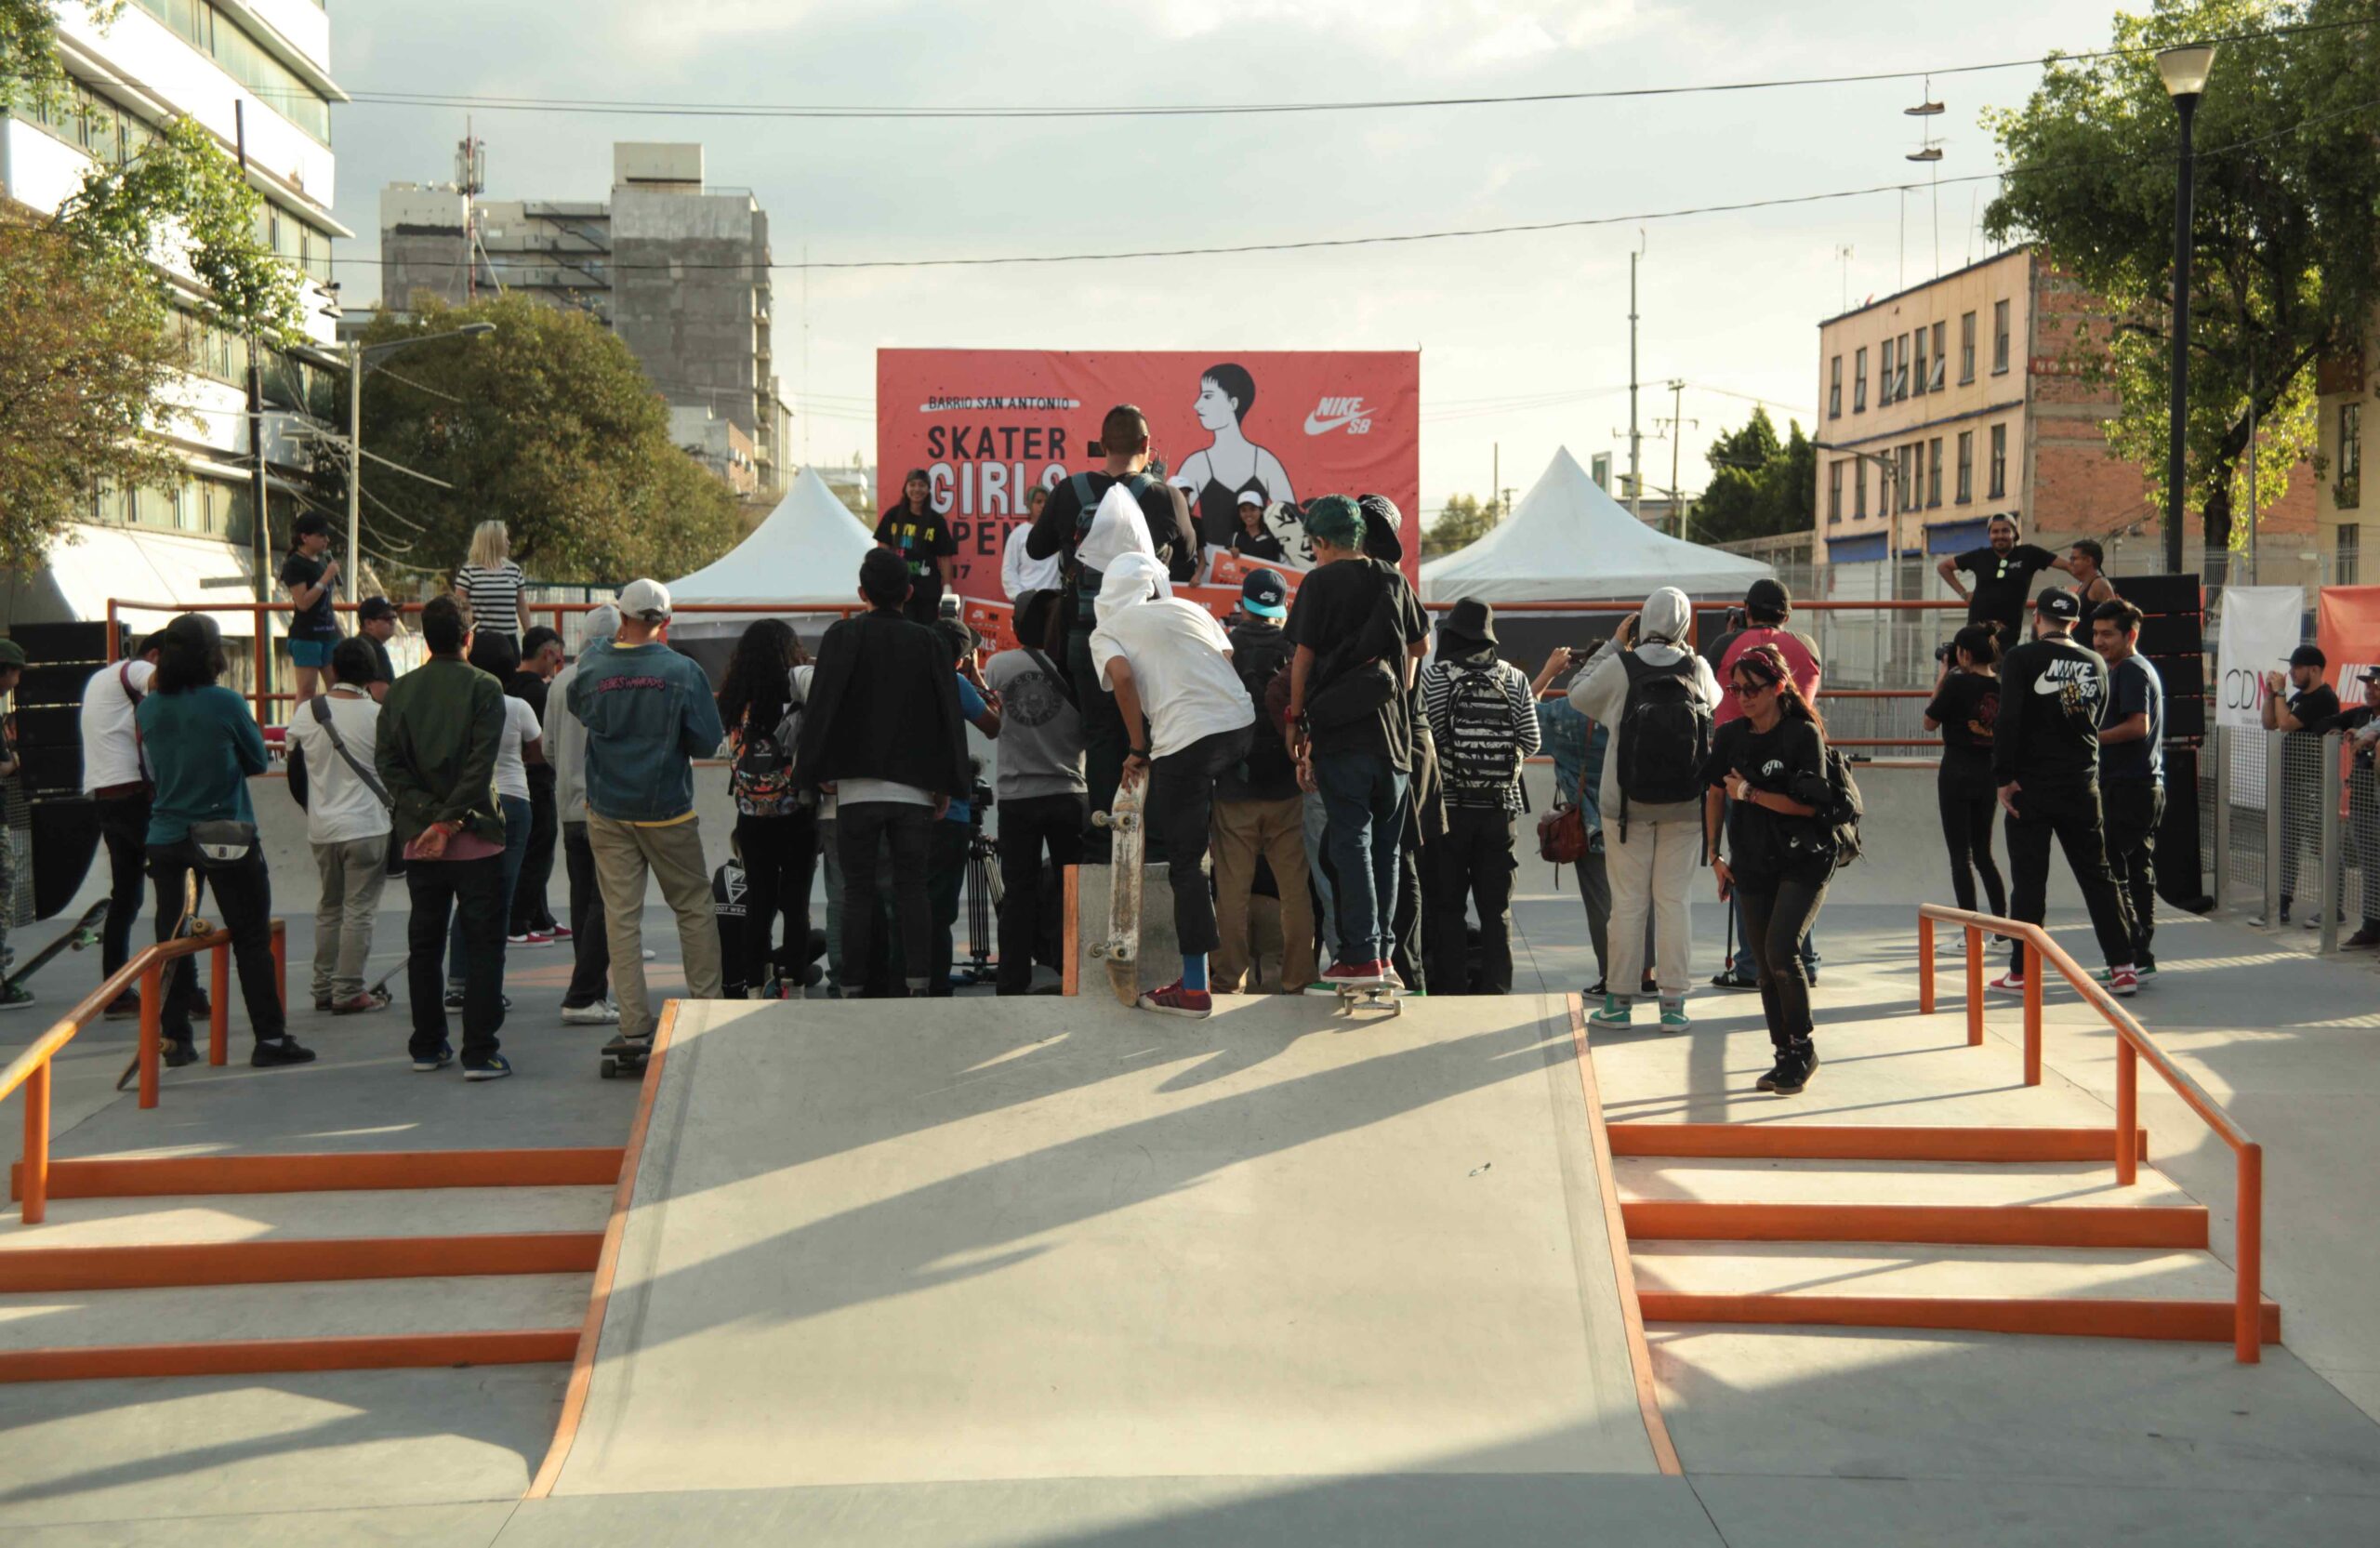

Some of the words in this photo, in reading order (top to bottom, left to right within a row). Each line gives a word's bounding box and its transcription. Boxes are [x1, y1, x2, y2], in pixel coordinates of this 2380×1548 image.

[929, 396, 972, 410] BARRIO
[977, 397, 1003, 410] SAN
[1008, 397, 1069, 411] ANTONIO
[1316, 397, 1364, 417] NIKE
[1347, 418, 1372, 434] SB
[928, 425, 1066, 460] SKATER
[2046, 658, 2093, 682] NIKE
[2080, 682, 2098, 698] SB
[2335, 663, 2380, 704] NIK
